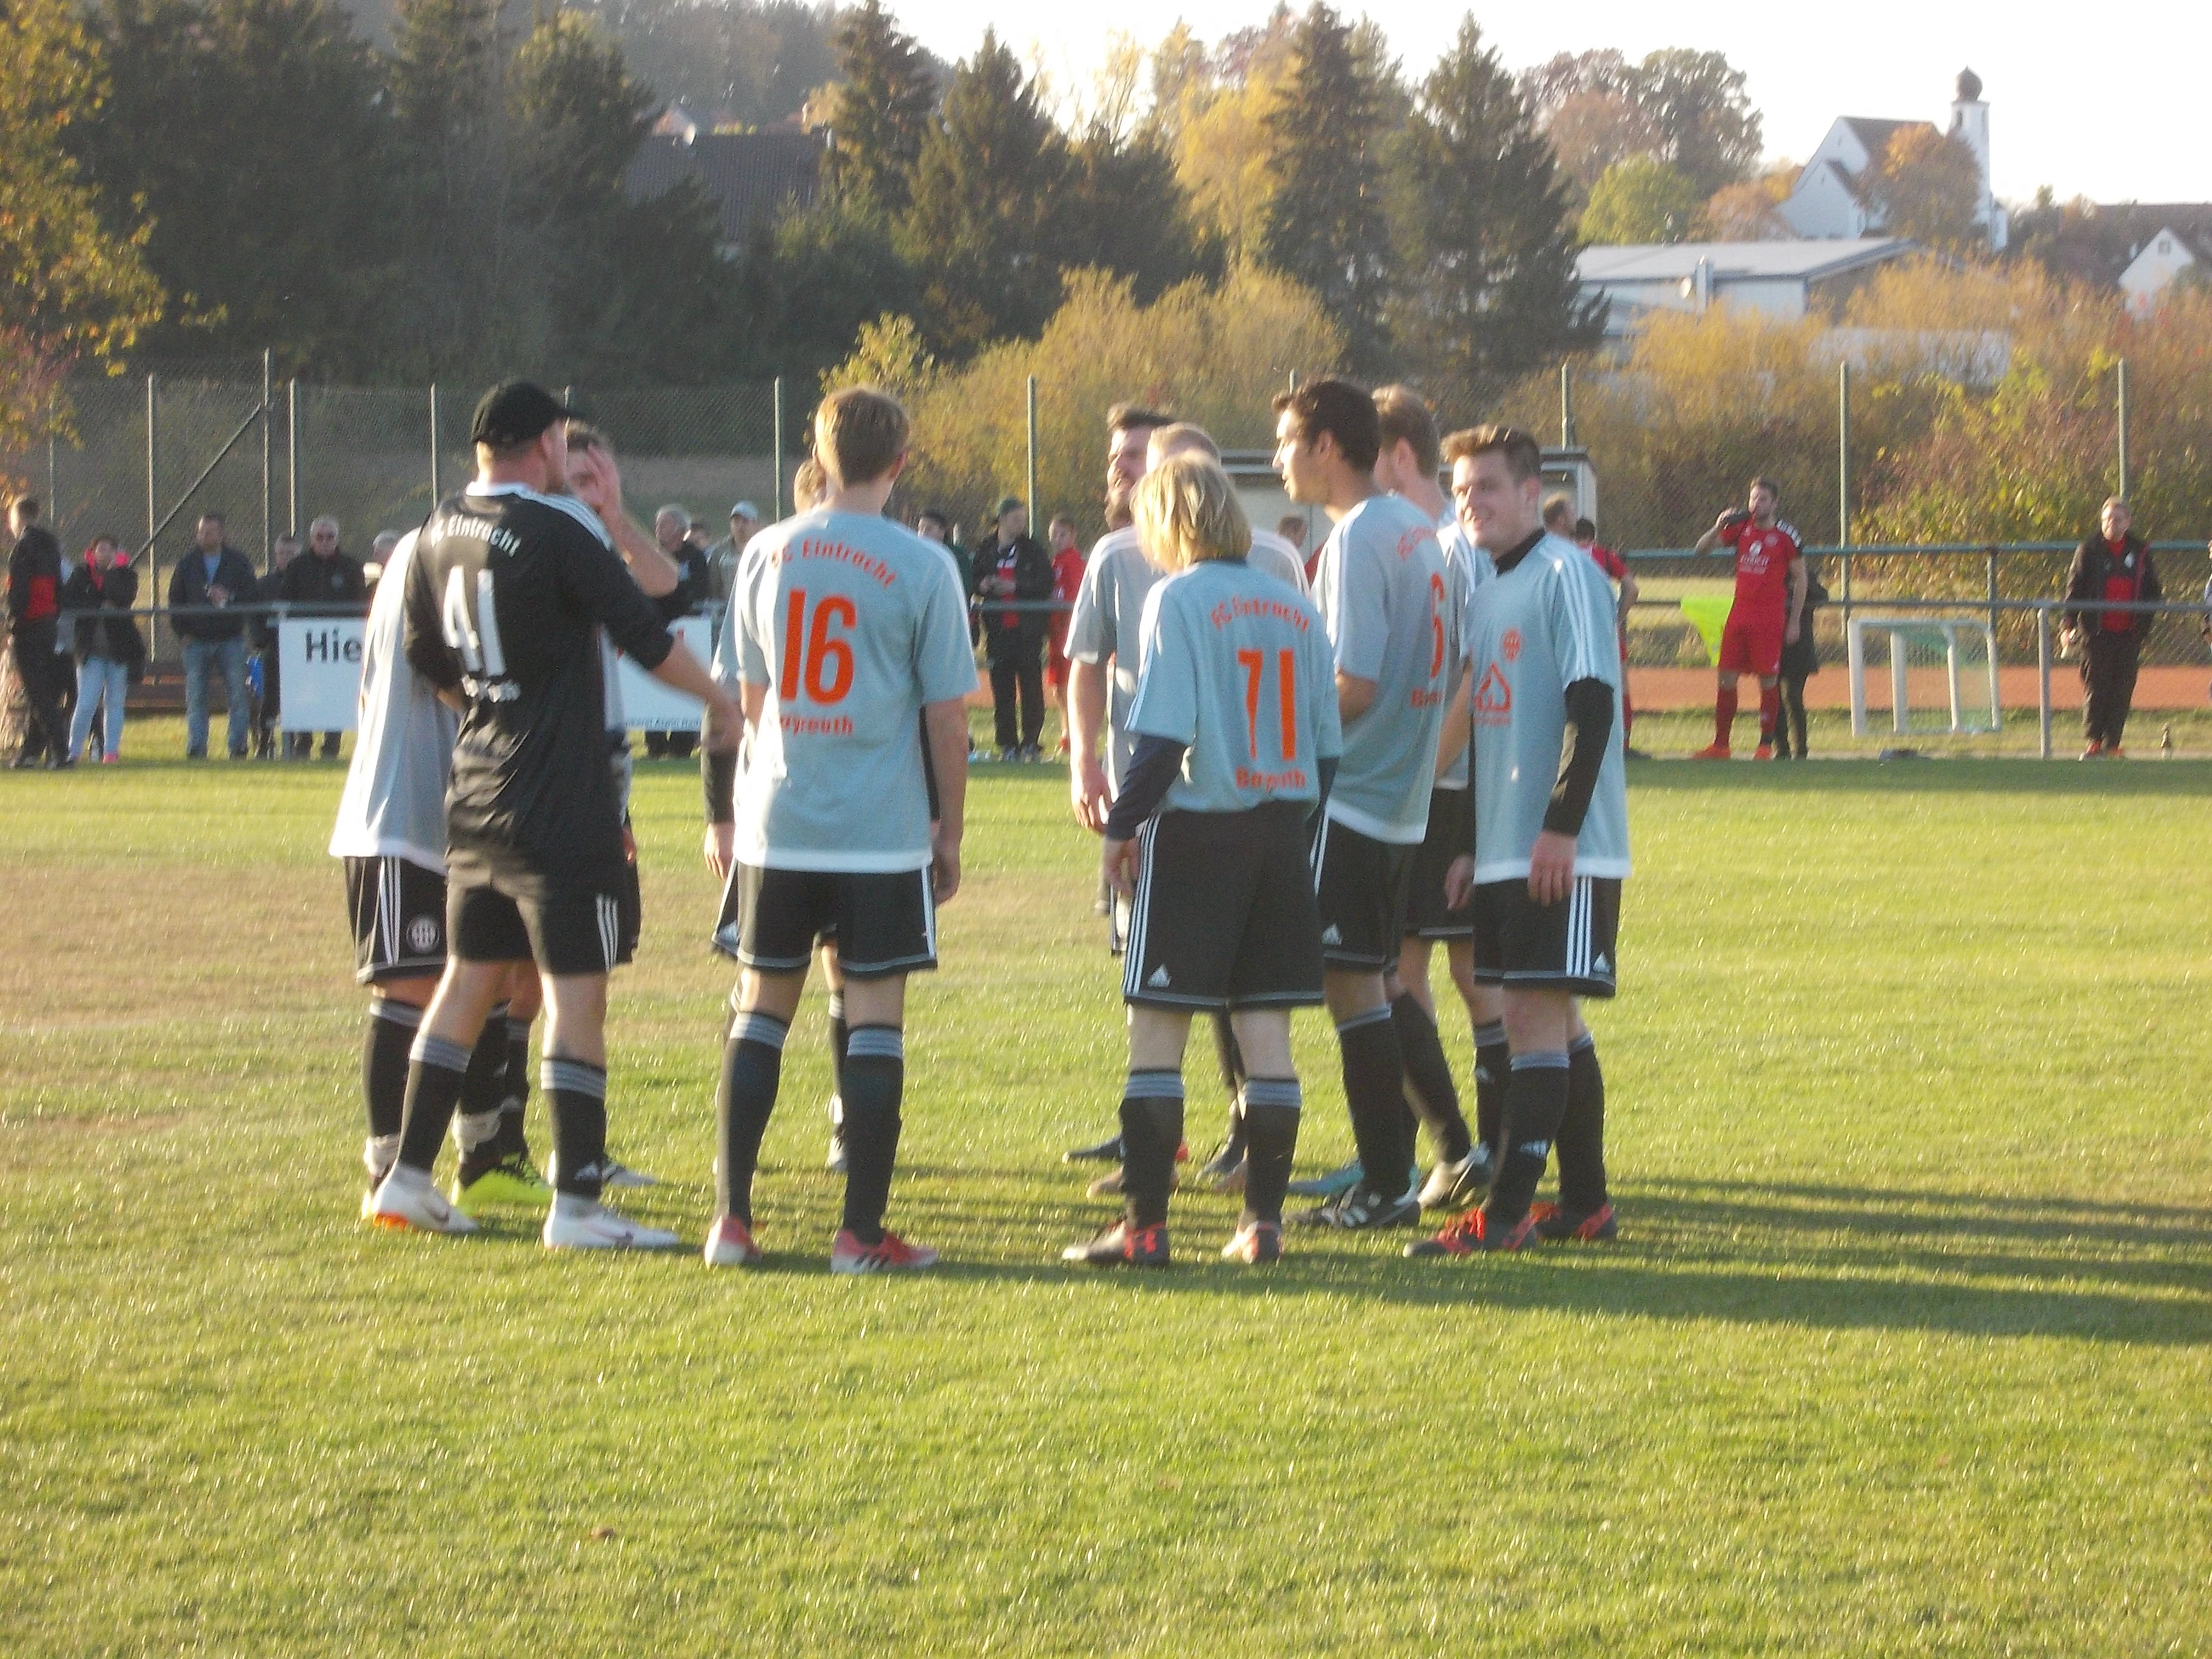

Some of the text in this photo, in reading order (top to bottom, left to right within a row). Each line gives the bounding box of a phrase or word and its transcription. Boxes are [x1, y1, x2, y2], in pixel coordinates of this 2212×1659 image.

[447, 514, 522, 558] Eintracht
[801, 537, 897, 589] Eintracht
[780, 588, 857, 706] 16
[779, 714, 854, 738] ayreuth
